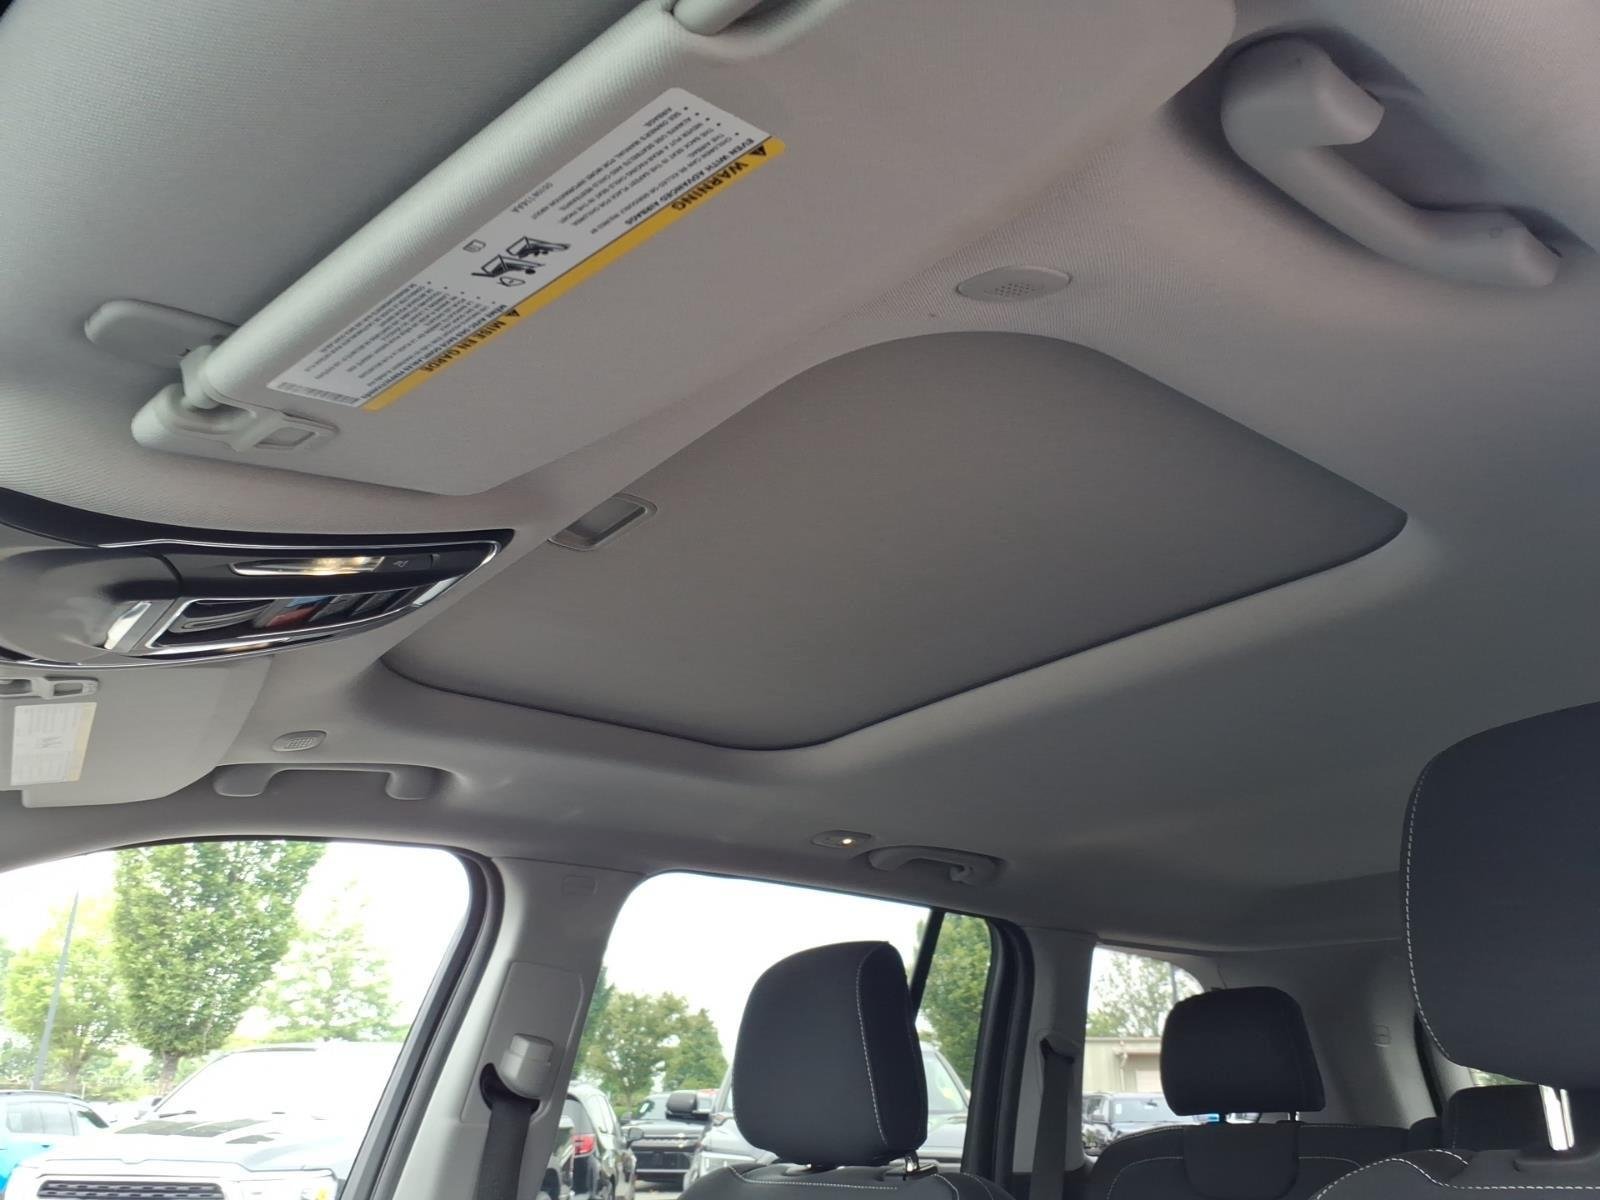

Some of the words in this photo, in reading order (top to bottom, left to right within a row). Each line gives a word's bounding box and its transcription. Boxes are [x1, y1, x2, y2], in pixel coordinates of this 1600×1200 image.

[726, 137, 756, 156] EVEN
[701, 154, 731, 172] WITH
[668, 159, 750, 211] WARNING
[471, 319, 507, 339] MISE
[455, 338, 479, 350] EN
[419, 348, 463, 372] GARDE
